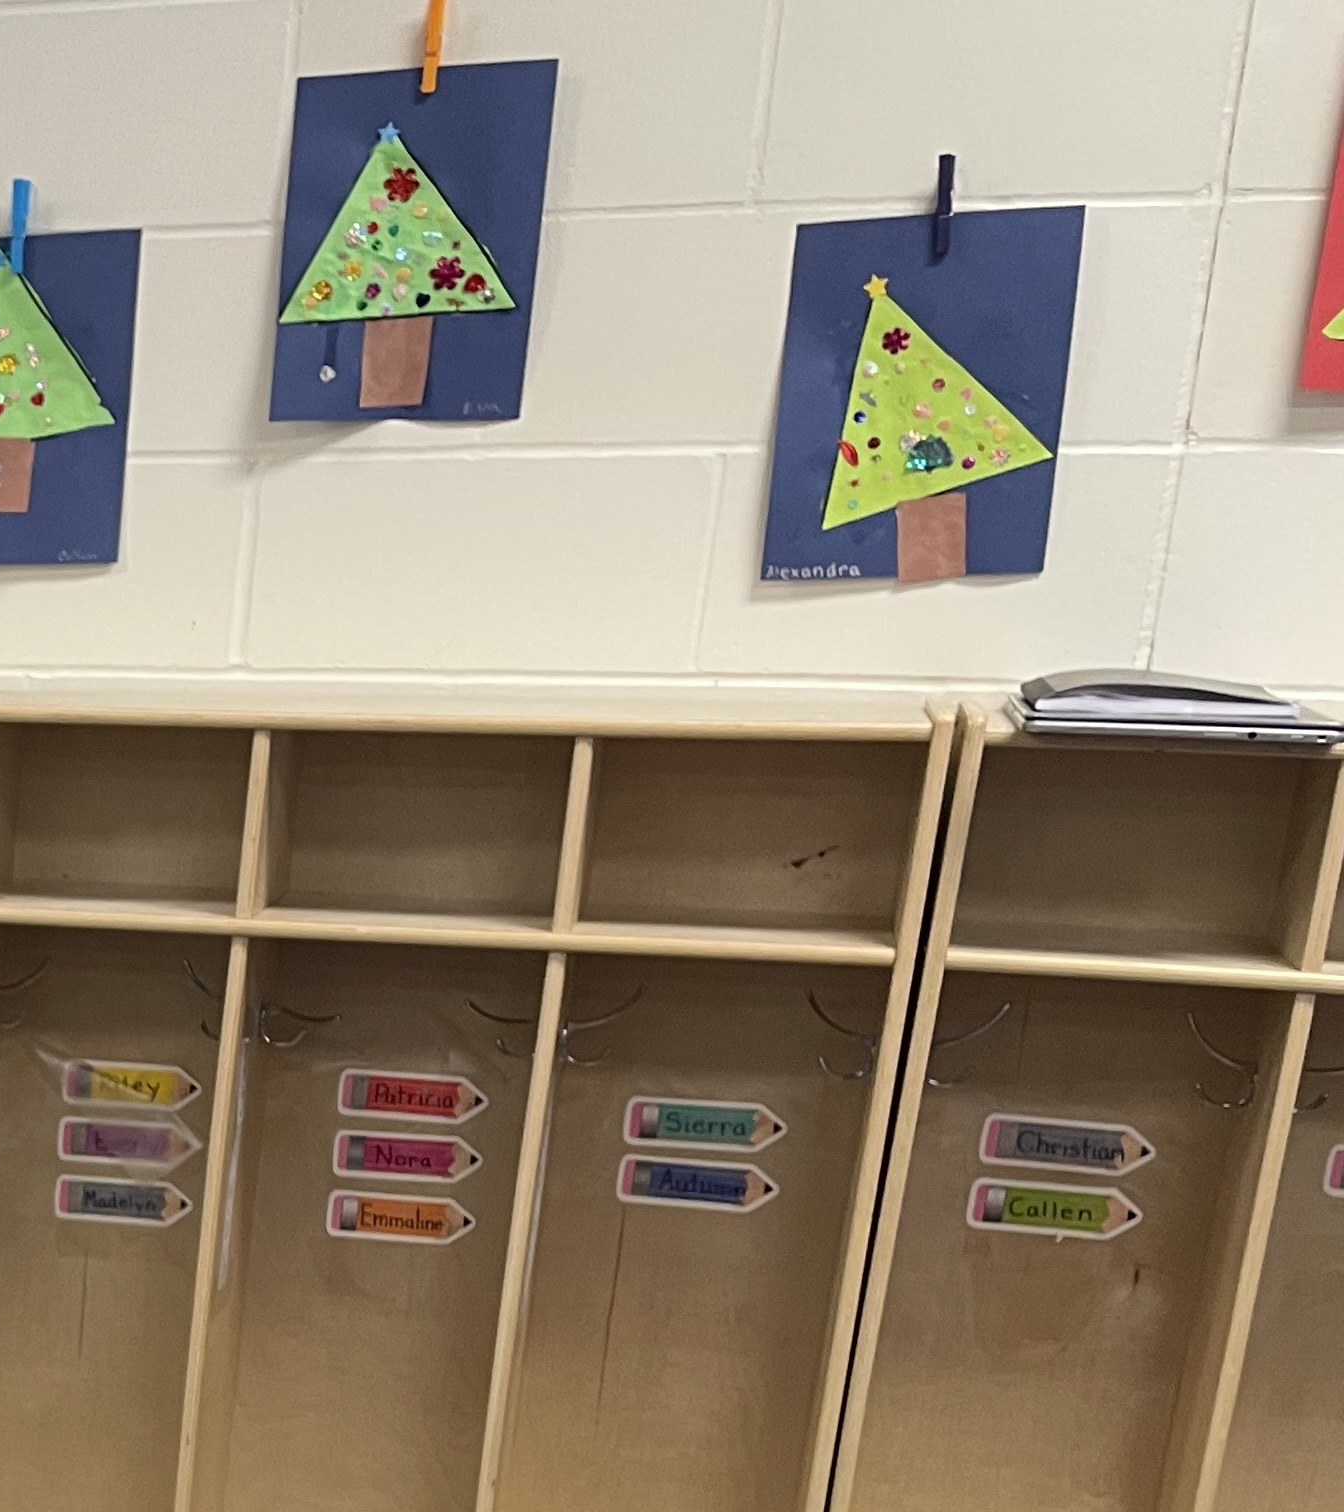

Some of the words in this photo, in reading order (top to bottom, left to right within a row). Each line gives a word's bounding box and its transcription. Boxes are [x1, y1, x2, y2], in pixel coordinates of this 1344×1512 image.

[765, 562, 861, 580] Alexandra
[374, 1082, 455, 1109] Patricia
[665, 1111, 746, 1137] Sierra
[374, 1144, 432, 1169] Nora
[1016, 1129, 1125, 1164] Christian
[359, 1203, 445, 1232] Emmaline
[1008, 1196, 1093, 1222] Callen
